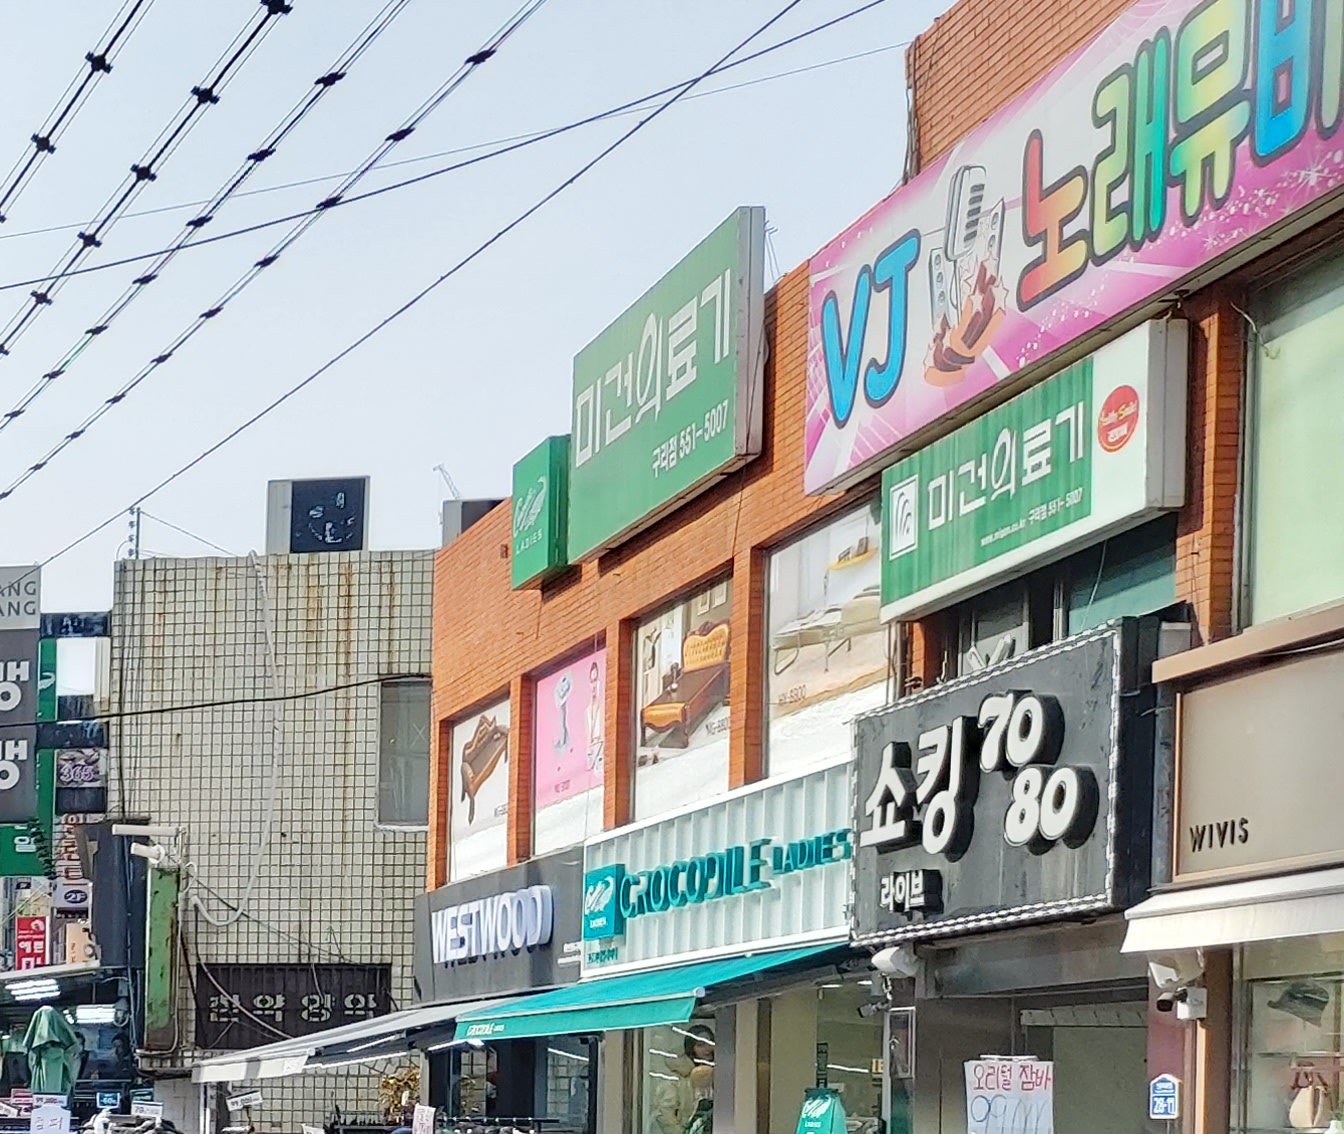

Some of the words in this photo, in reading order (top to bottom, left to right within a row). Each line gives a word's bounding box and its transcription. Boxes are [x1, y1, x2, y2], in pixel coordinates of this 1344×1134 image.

[576, 268, 730, 468] 미건의료기
[820, 229, 921, 428] VJ
[679, 399, 729, 461] 551-5007
[928, 401, 1084, 530] 미건의료기
[978, 692, 1044, 773] 70
[860, 716, 965, 855] 쇼킹
[1004, 766, 1080, 848] 80
[619, 838, 773, 919] CROCODILE
[773, 829, 852, 876] LADIES
[1188, 817, 1249, 853] WIVIS
[66, 892, 87, 903] 2F
[431, 884, 555, 967] WESTWOOD
[879, 872, 926, 910] 라이브
[973, 1064, 1013, 1092] 오리털
